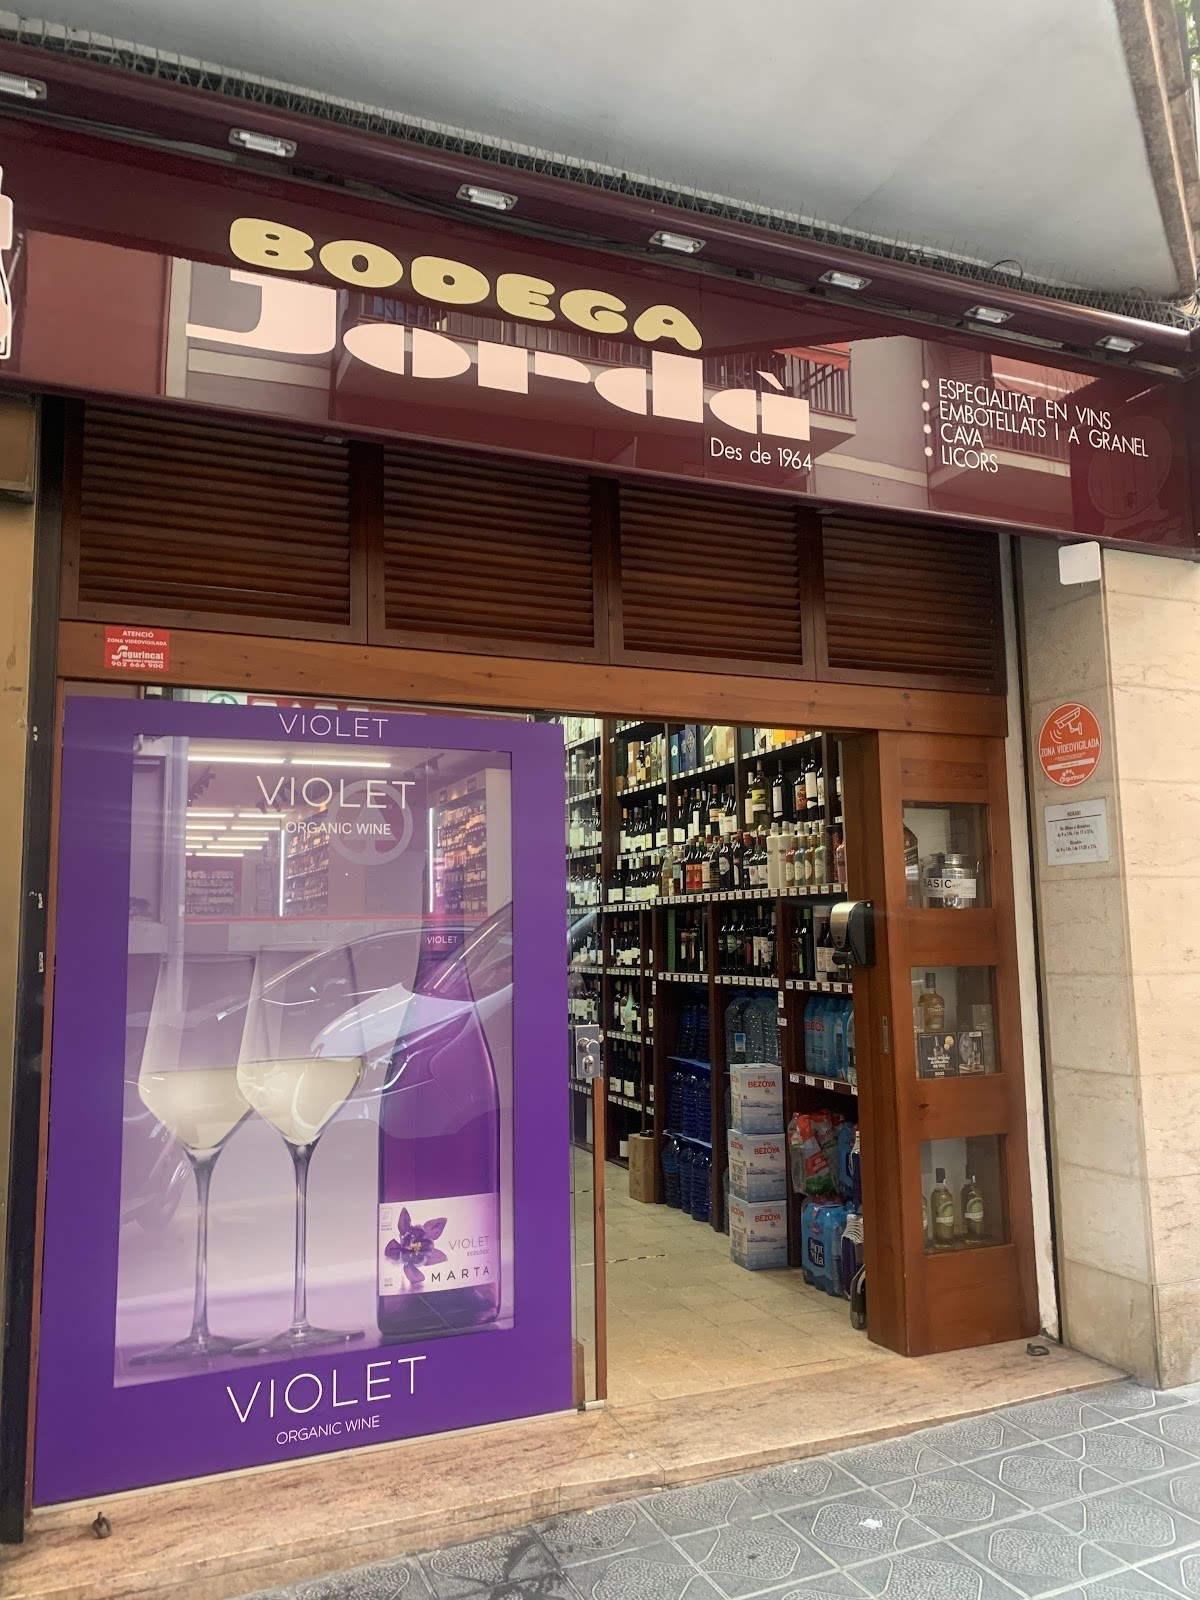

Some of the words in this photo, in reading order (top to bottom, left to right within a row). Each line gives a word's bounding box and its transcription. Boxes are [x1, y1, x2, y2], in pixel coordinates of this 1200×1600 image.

[229, 217, 703, 351] BODEGA
[186, 269, 810, 441] Jordà
[938, 378, 1036, 415] ESPECIALITAT
[1046, 400, 1067, 421] EN
[1075, 405, 1111, 430] VINS
[939, 400, 1046, 438] EMBOTELLATS
[1054, 422, 1059, 441] I
[1068, 426, 1080, 445] A
[1088, 429, 1149, 458] GRANEL
[940, 422, 985, 448] CAVA
[710, 436, 743, 461] Des
[749, 441, 772, 465] de
[777, 447, 813, 472] 1964
[941, 445, 999, 473] LICORS
[278, 713, 389, 739] VIOLET
[1041, 747, 1056, 758] ZONA
[1056, 738, 1100, 754] VIDEOVIGILADA
[256, 775, 416, 810] VIOLET
[285, 821, 352, 835] ORGANIC
[356, 822, 392, 835] WINE
[426, 935, 458, 944] VIOLET
[747, 1080, 776, 1088] BEZOYA
[754, 1146, 780, 1155] BEZOYA
[755, 1213, 781, 1222] BEZOYA
[449, 1235, 490, 1250] VIOLET
[226, 1355, 427, 1423] VIOLET
[276, 1421, 342, 1445] ORGANIC
[345, 1415, 381, 1432] WINE
